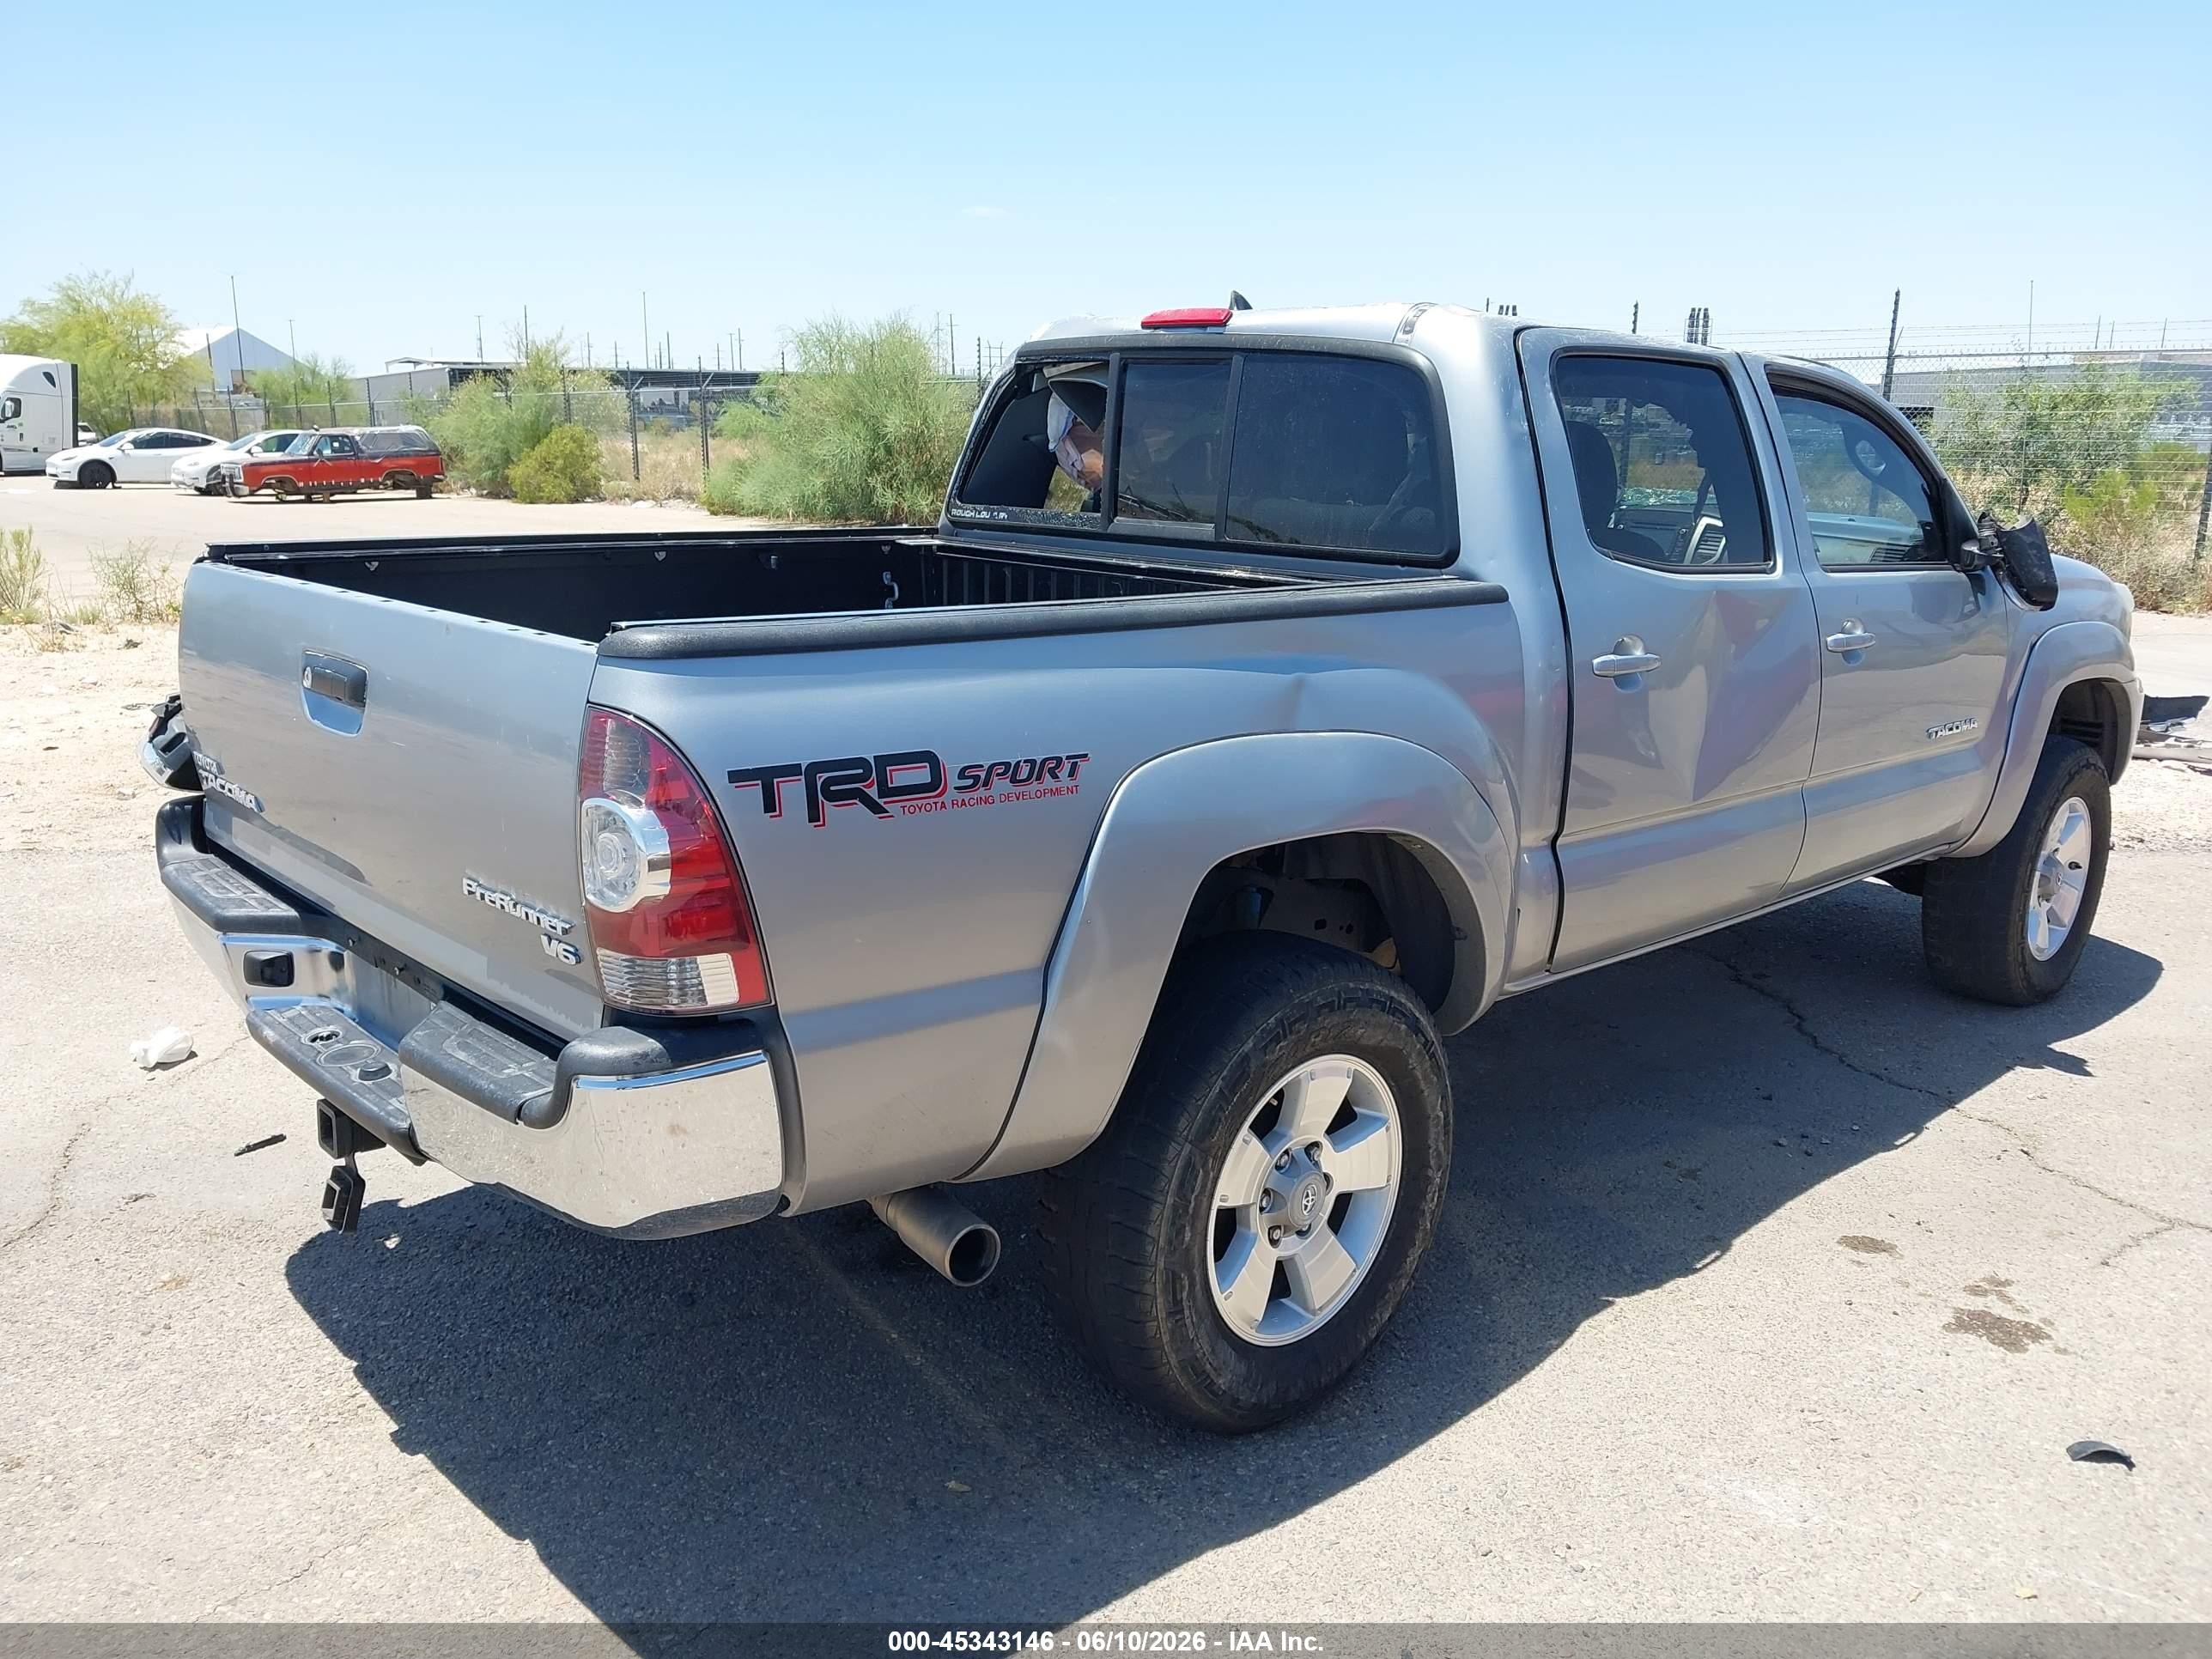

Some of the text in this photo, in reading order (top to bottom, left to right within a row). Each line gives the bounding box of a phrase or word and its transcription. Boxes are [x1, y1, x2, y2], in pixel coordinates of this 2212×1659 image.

[1926, 718, 1978, 739] TACOMA
[192, 750, 220, 775] TOYOTA
[197, 769, 260, 812] TACOMA
[727, 750, 1090, 827] TRD SPORT
[900, 785, 1080, 816] TOYOTA RACING DEVELOPMENT
[462, 877, 576, 936] PreRunner
[540, 933, 581, 965] V6
